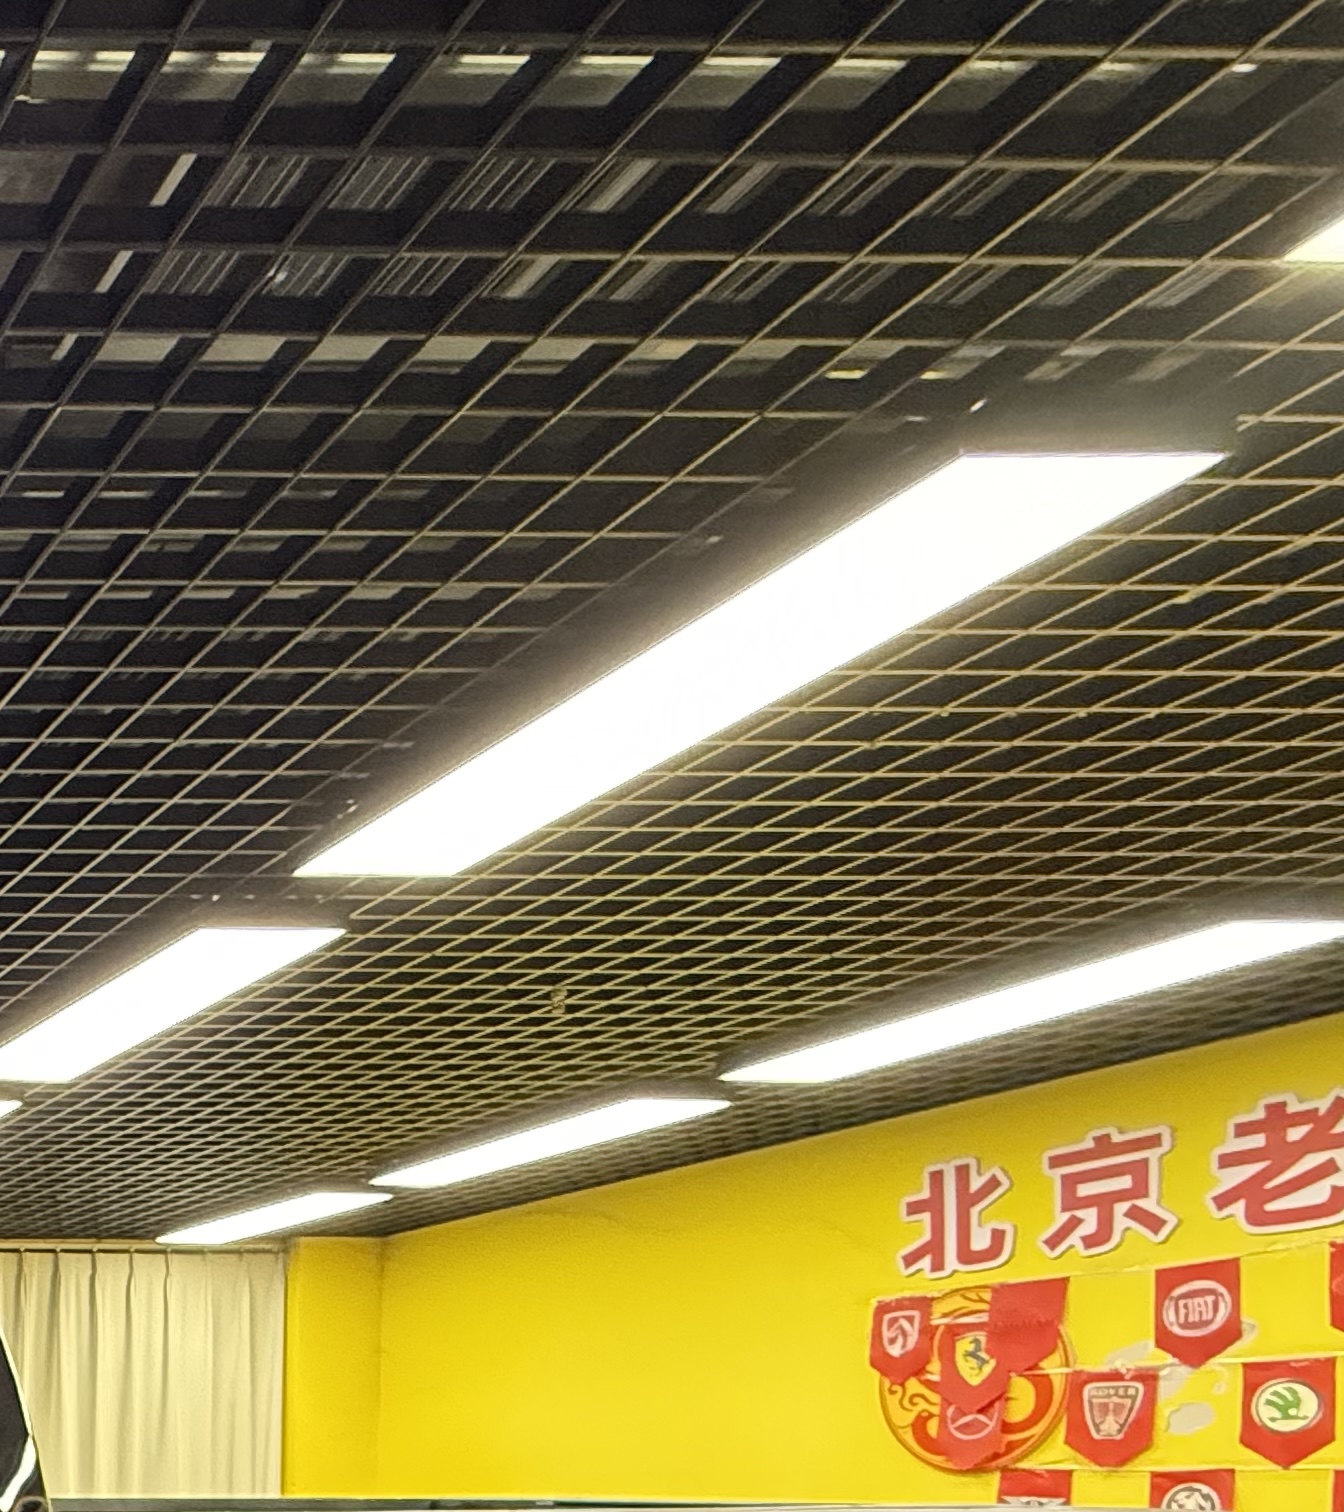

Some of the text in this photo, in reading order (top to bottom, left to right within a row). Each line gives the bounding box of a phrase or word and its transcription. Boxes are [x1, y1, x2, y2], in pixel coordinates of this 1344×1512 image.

[899, 1091, 1344, 1278] 北京老
[1177, 1295, 1217, 1324] FIAT
